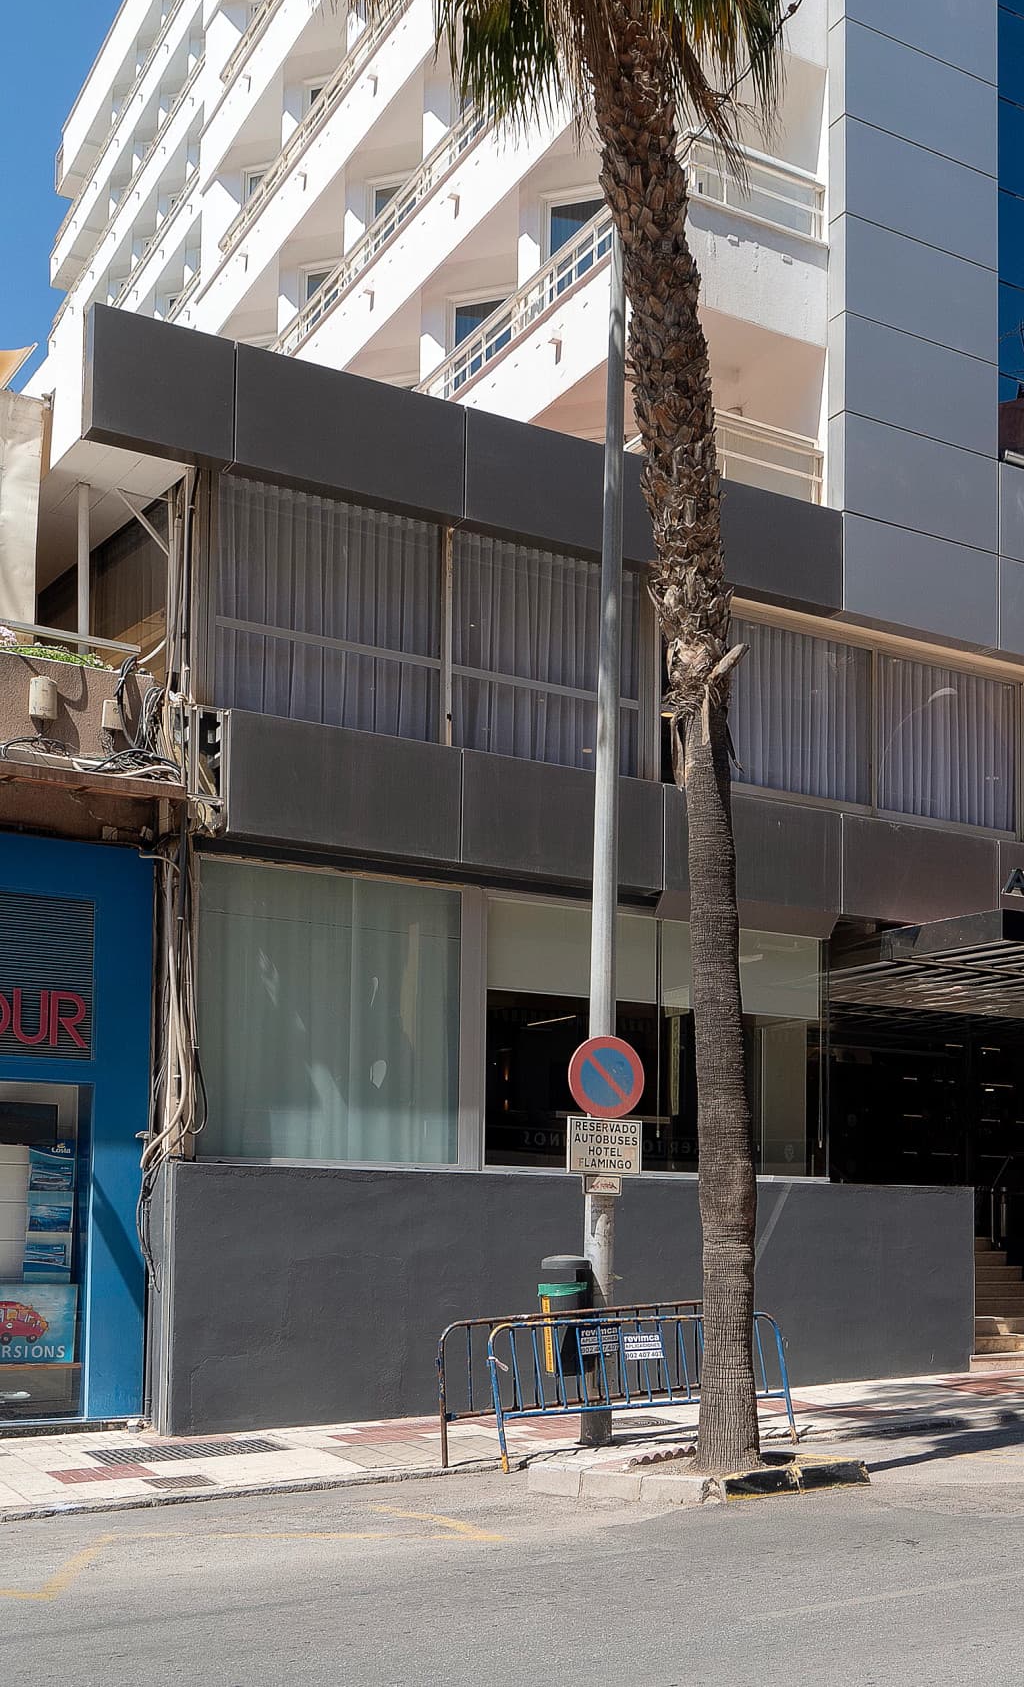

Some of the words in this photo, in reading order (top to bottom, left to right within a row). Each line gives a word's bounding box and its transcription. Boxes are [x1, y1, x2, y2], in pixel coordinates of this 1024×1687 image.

[0, 986, 88, 1048] UR
[575, 1120, 637, 1134] RESERVADO
[574, 1133, 638, 1146] AUTOBUSES
[588, 1145, 622, 1157] HOTEL
[577, 1157, 632, 1170] FLAMINGO
[581, 1327, 618, 1337] revmca
[623, 1334, 660, 1342] revimca
